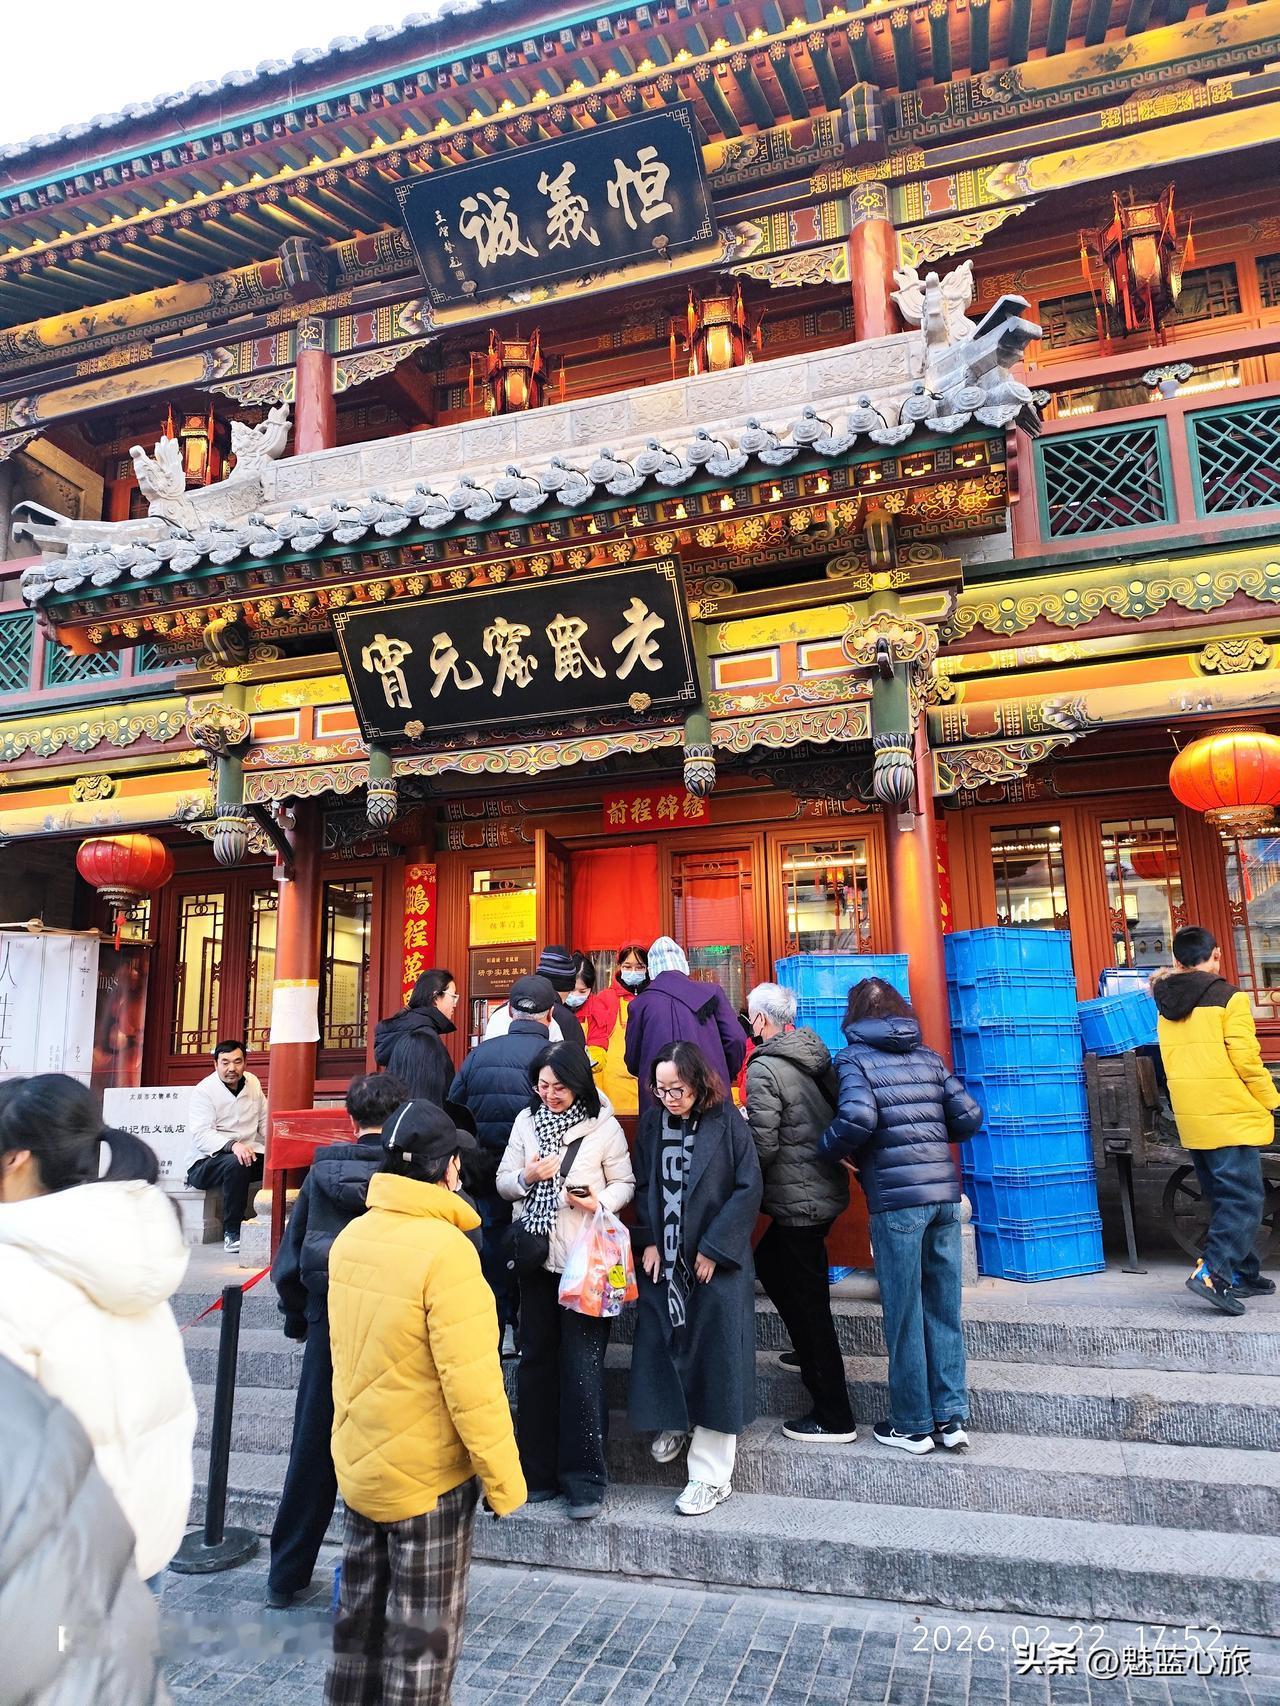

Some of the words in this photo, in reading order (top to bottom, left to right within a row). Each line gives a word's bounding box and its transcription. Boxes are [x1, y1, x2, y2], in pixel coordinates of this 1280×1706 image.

[361, 597, 667, 708] 老鼠窟元宵
